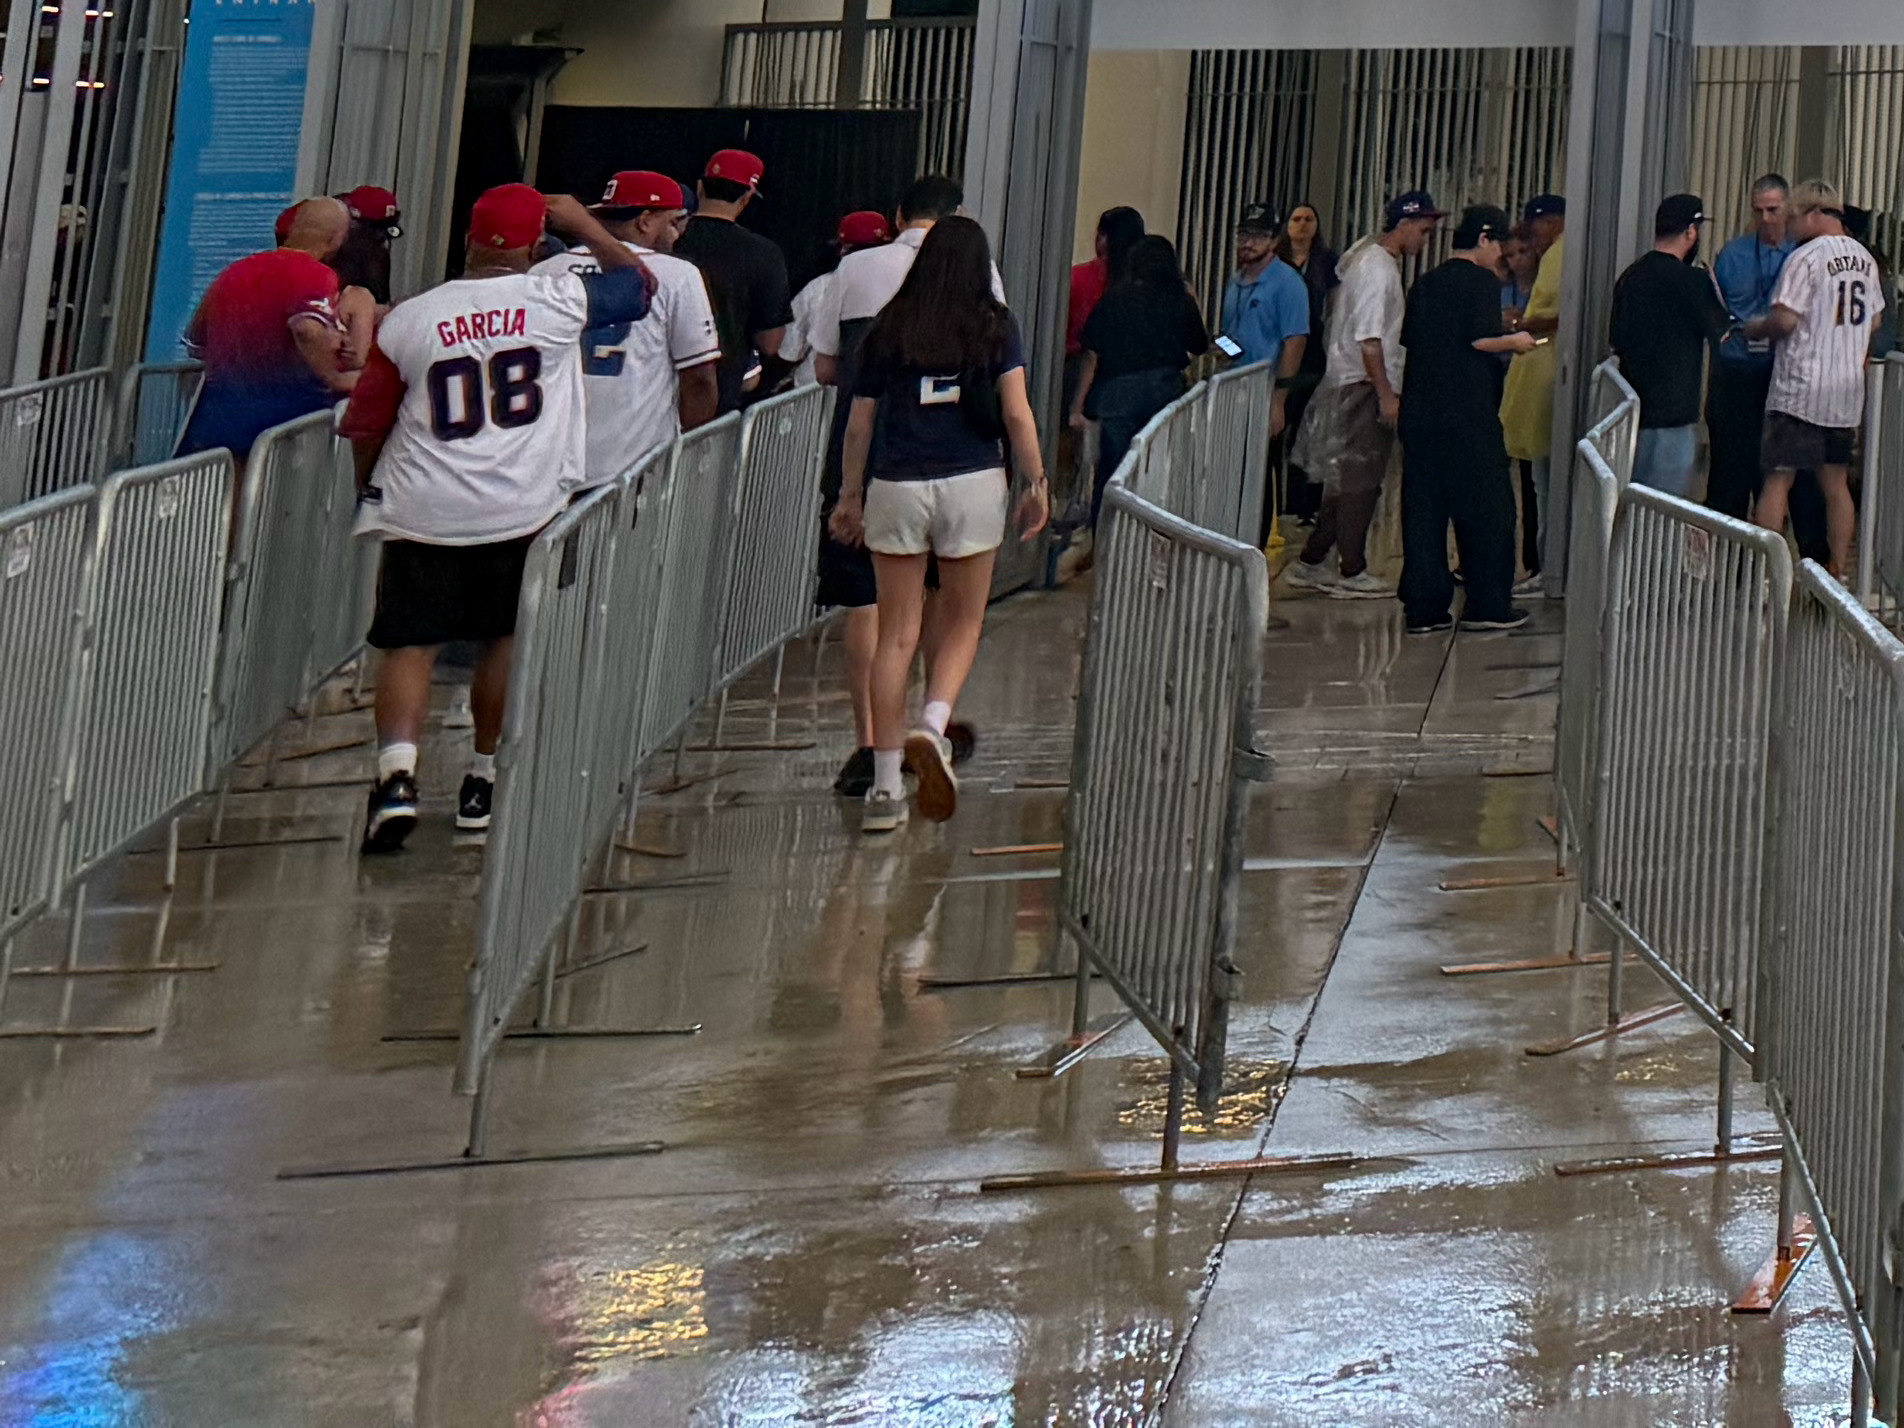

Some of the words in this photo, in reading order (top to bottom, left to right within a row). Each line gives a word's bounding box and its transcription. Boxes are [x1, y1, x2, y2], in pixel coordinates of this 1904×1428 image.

[1835, 279, 1866, 327] 16
[437, 307, 527, 348] GARCIA
[427, 346, 544, 443] 08
